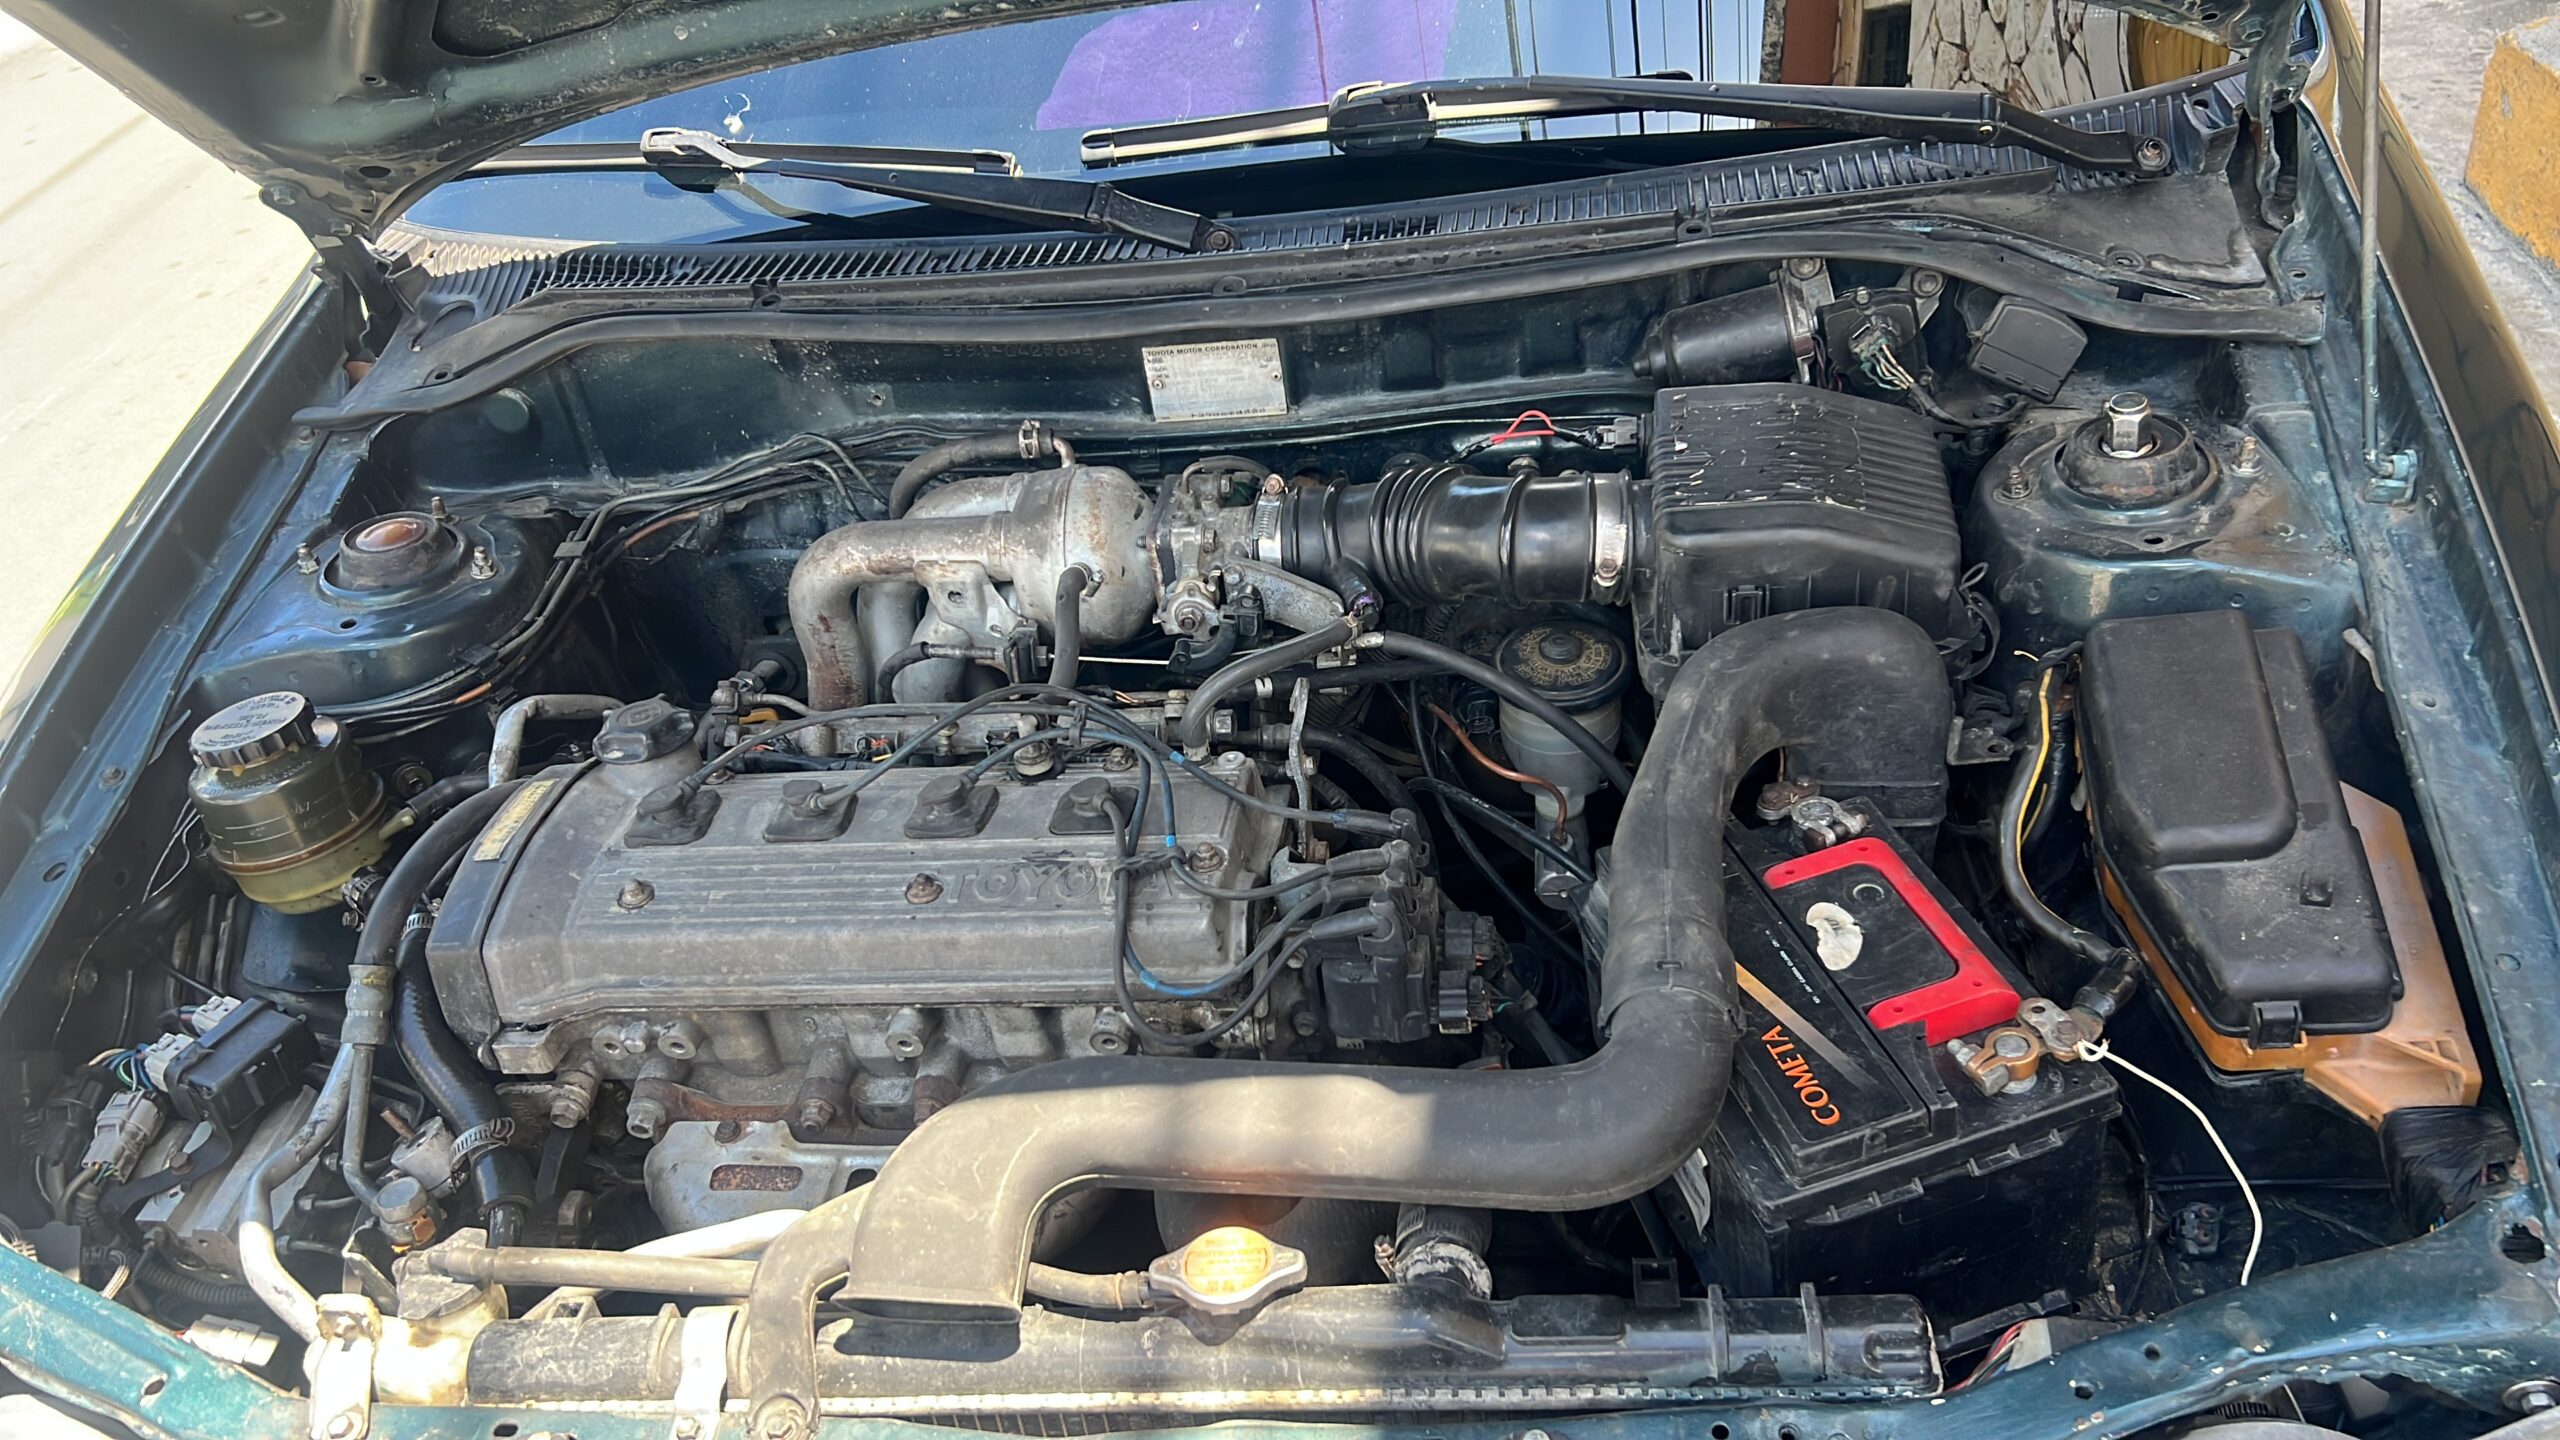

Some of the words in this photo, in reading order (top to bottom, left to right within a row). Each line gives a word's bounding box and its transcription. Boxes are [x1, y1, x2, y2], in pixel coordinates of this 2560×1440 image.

[1147, 349, 1175, 357] TOYOTA
[1204, 343, 1258, 353] CORPORATION
[1761, 1024, 1842, 1126] COMETA
